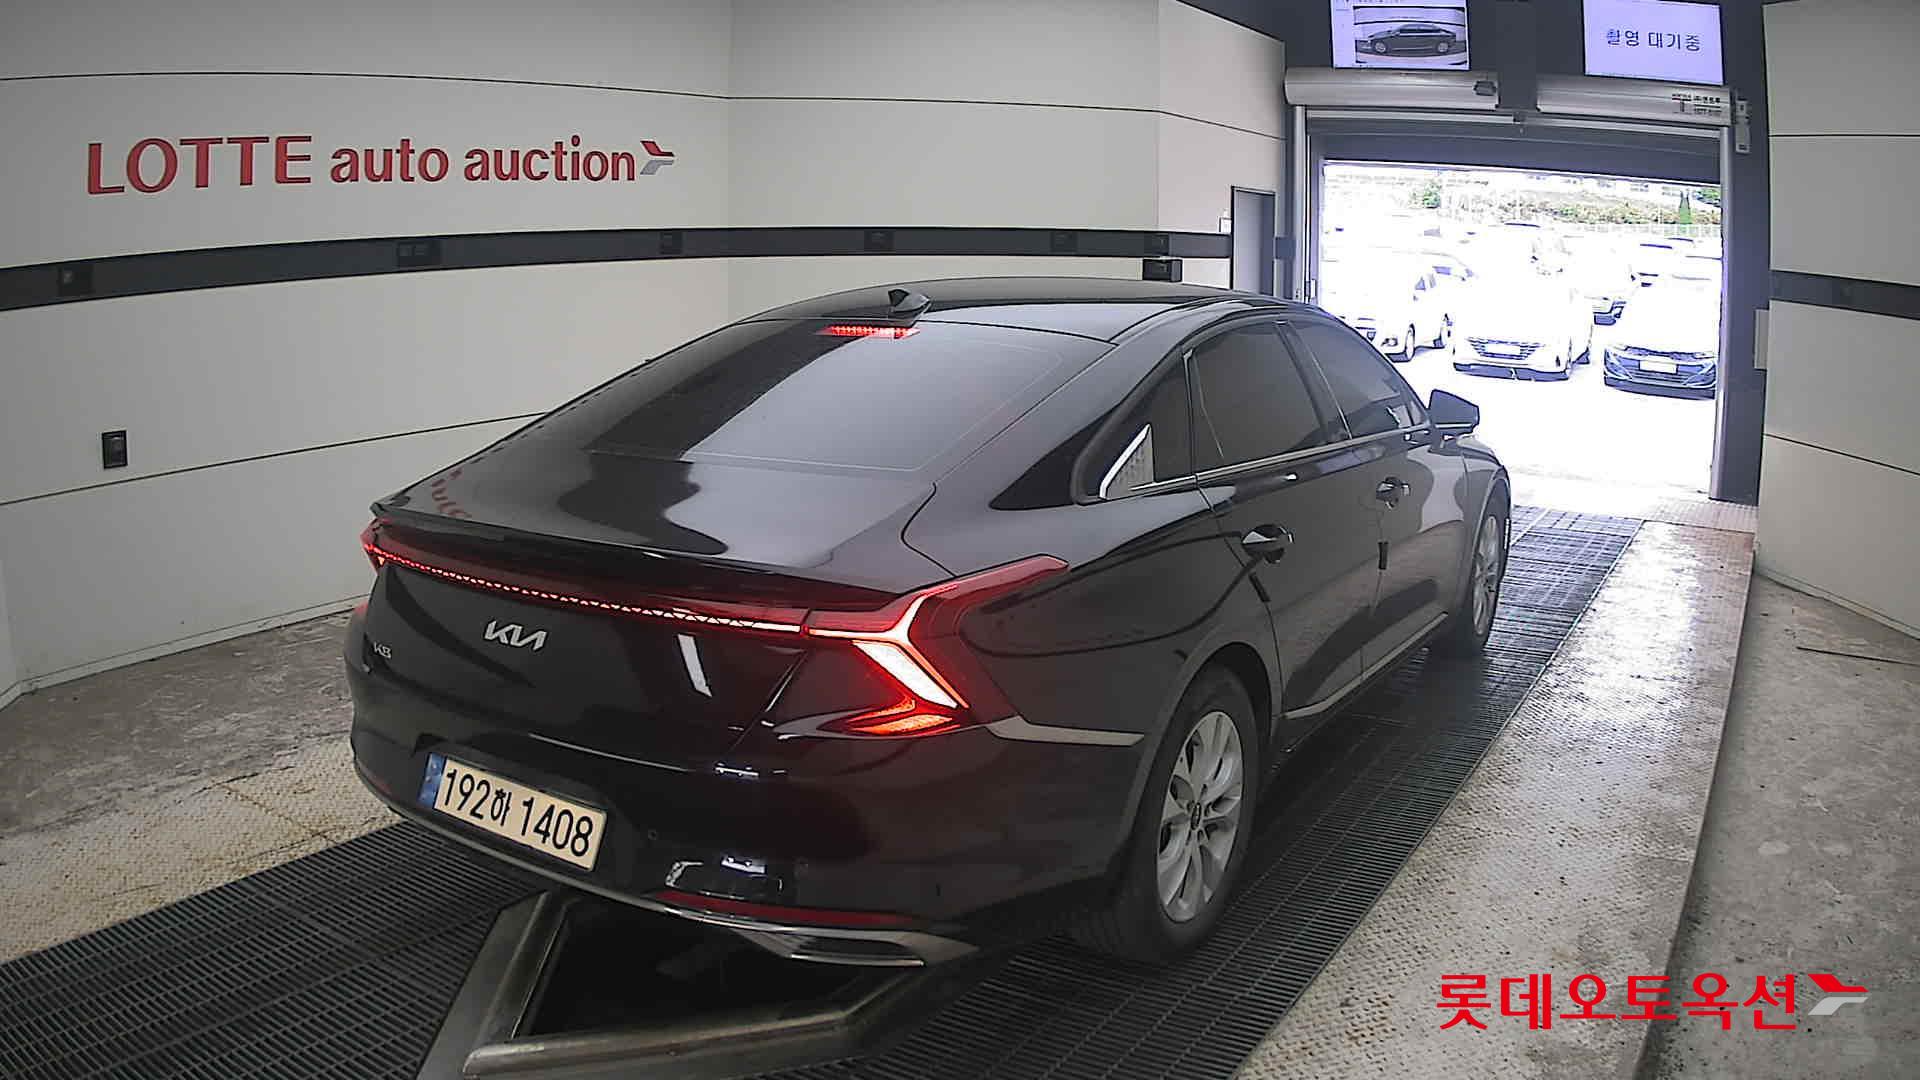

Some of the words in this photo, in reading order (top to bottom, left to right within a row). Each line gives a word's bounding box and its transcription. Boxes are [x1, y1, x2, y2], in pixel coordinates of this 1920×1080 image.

[1647, 31, 1701, 52] 대기중
[87, 135, 312, 195] LOTTE
[330, 138, 449, 184] auto
[463, 135, 637, 182] auction
[373, 640, 392, 659] K8
[443, 767, 511, 827] 192하
[521, 796, 594, 858] 1408
